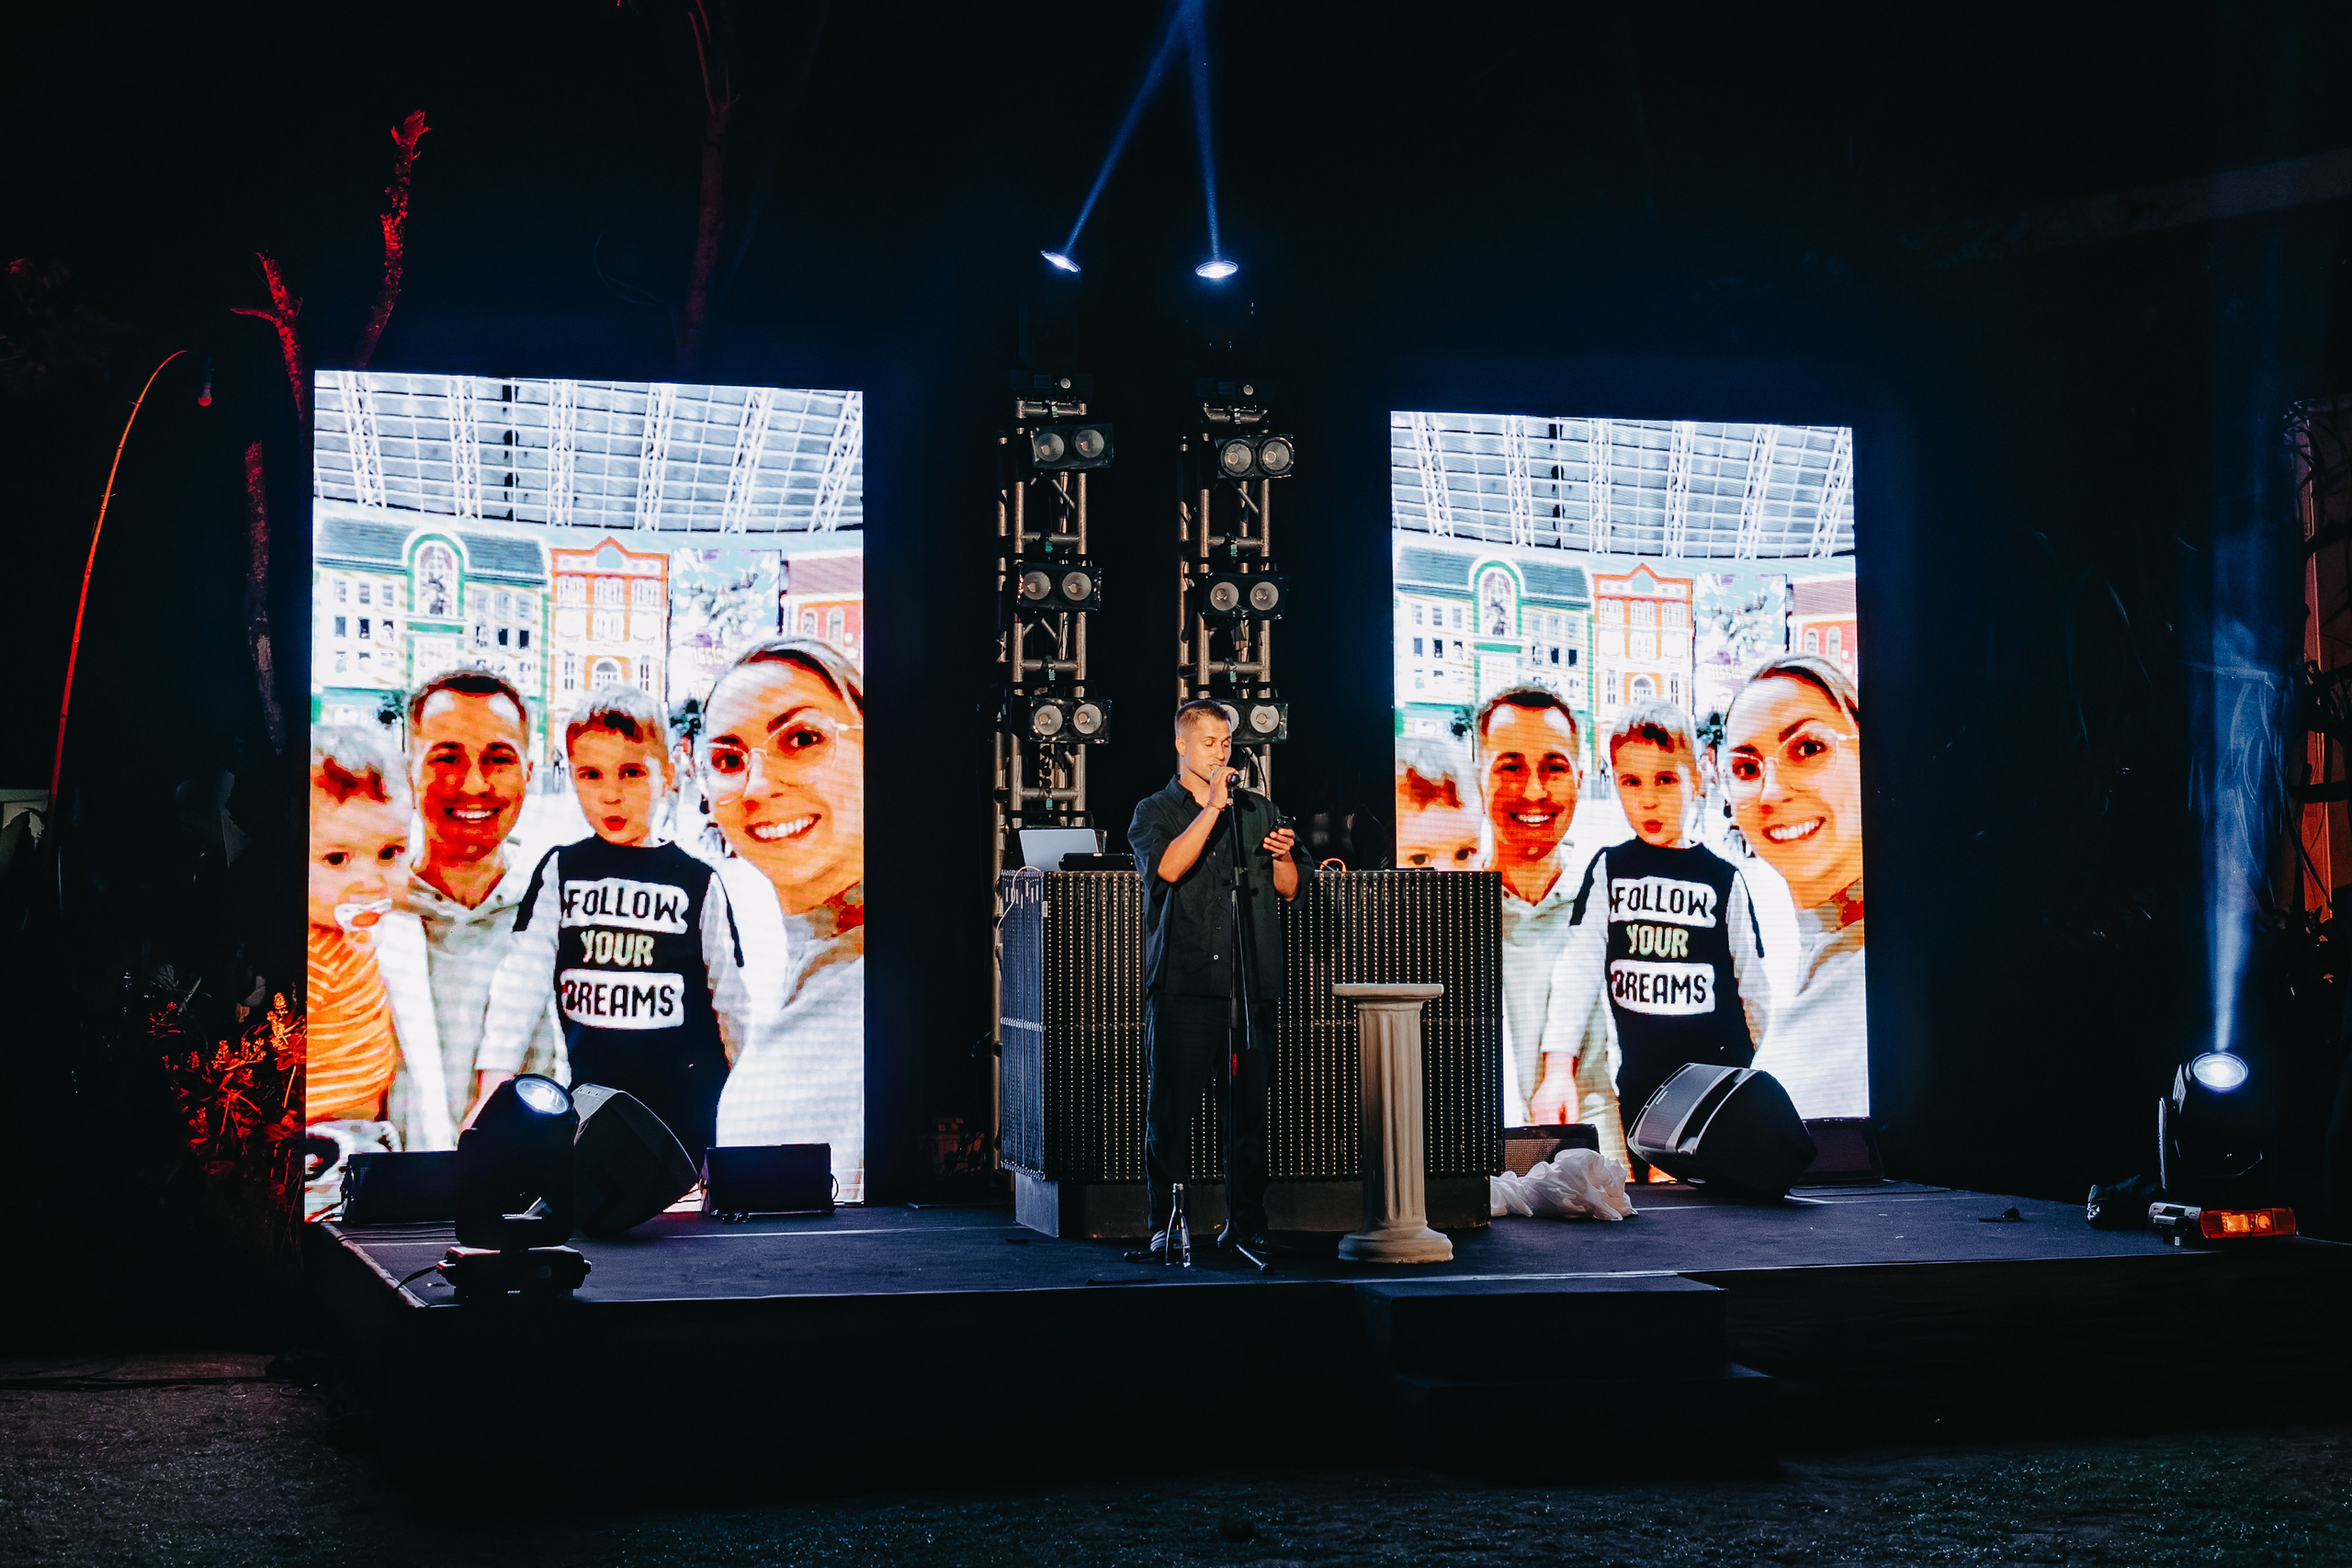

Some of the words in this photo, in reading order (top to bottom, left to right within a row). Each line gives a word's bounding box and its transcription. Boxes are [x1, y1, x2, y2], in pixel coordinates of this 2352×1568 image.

[564, 886, 678, 923] FOLLOW
[1612, 885, 1708, 919] FOLLOW
[581, 930, 655, 967] YOUR
[1626, 924, 1689, 958] YOUR
